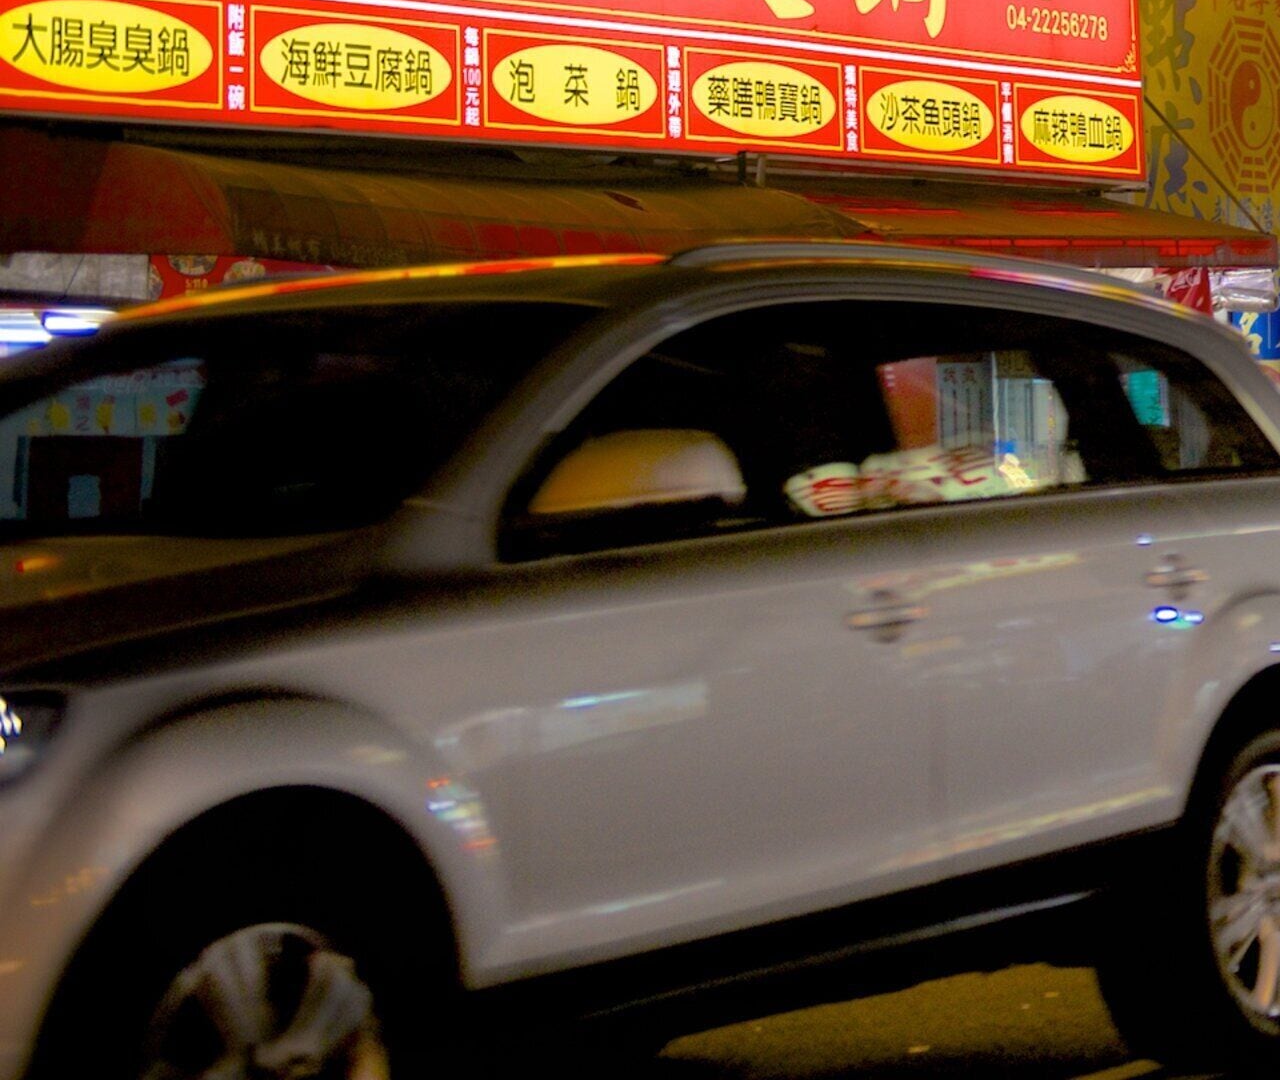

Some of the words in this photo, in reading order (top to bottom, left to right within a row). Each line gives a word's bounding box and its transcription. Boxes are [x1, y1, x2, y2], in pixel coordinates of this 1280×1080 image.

[11, 12, 190, 77] 大腸臭臭鍋
[1006, 4, 1109, 41] 04-22256278
[280, 37, 433, 96] 海鮮豆腐鍋
